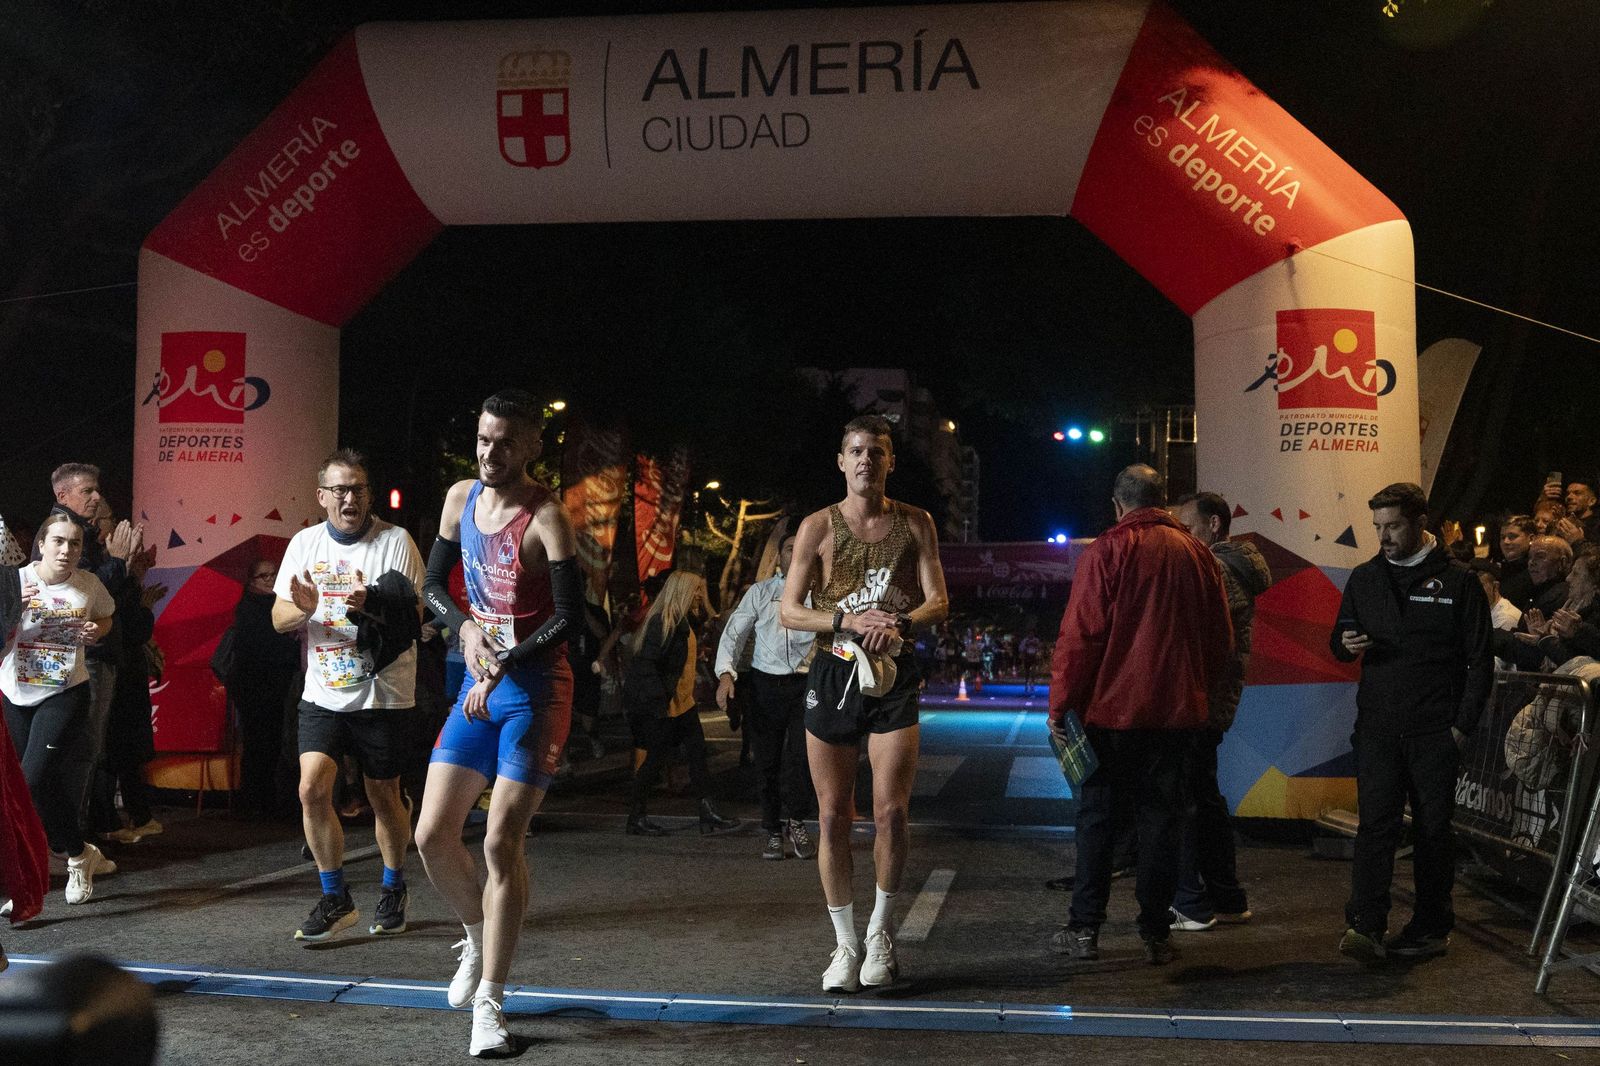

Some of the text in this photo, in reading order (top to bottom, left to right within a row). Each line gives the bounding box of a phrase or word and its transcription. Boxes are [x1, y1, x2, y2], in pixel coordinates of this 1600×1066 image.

[642, 29, 980, 101] ALMERÍA
[642, 112, 811, 153] CIUDAD
[1158, 87, 1301, 210] ALMERÍA
[215, 115, 338, 240] ALMERÍA
[1133, 114, 1276, 237] es deporte
[237, 136, 361, 263] es deporte
[1280, 421, 1379, 437] DEPORTES
[159, 435, 244, 449] DEPORTES
[1280, 438, 1379, 453] DE ALMERIA
[159, 450, 244, 463] DE ALMERIA
[865, 567, 891, 588] GO
[430, 596, 448, 615] CRAFT
[837, 584, 911, 613] TRAINING
[543, 618, 568, 641] CRAFT
[30, 660, 60, 671] 1606
[331, 659, 356, 672] 354
